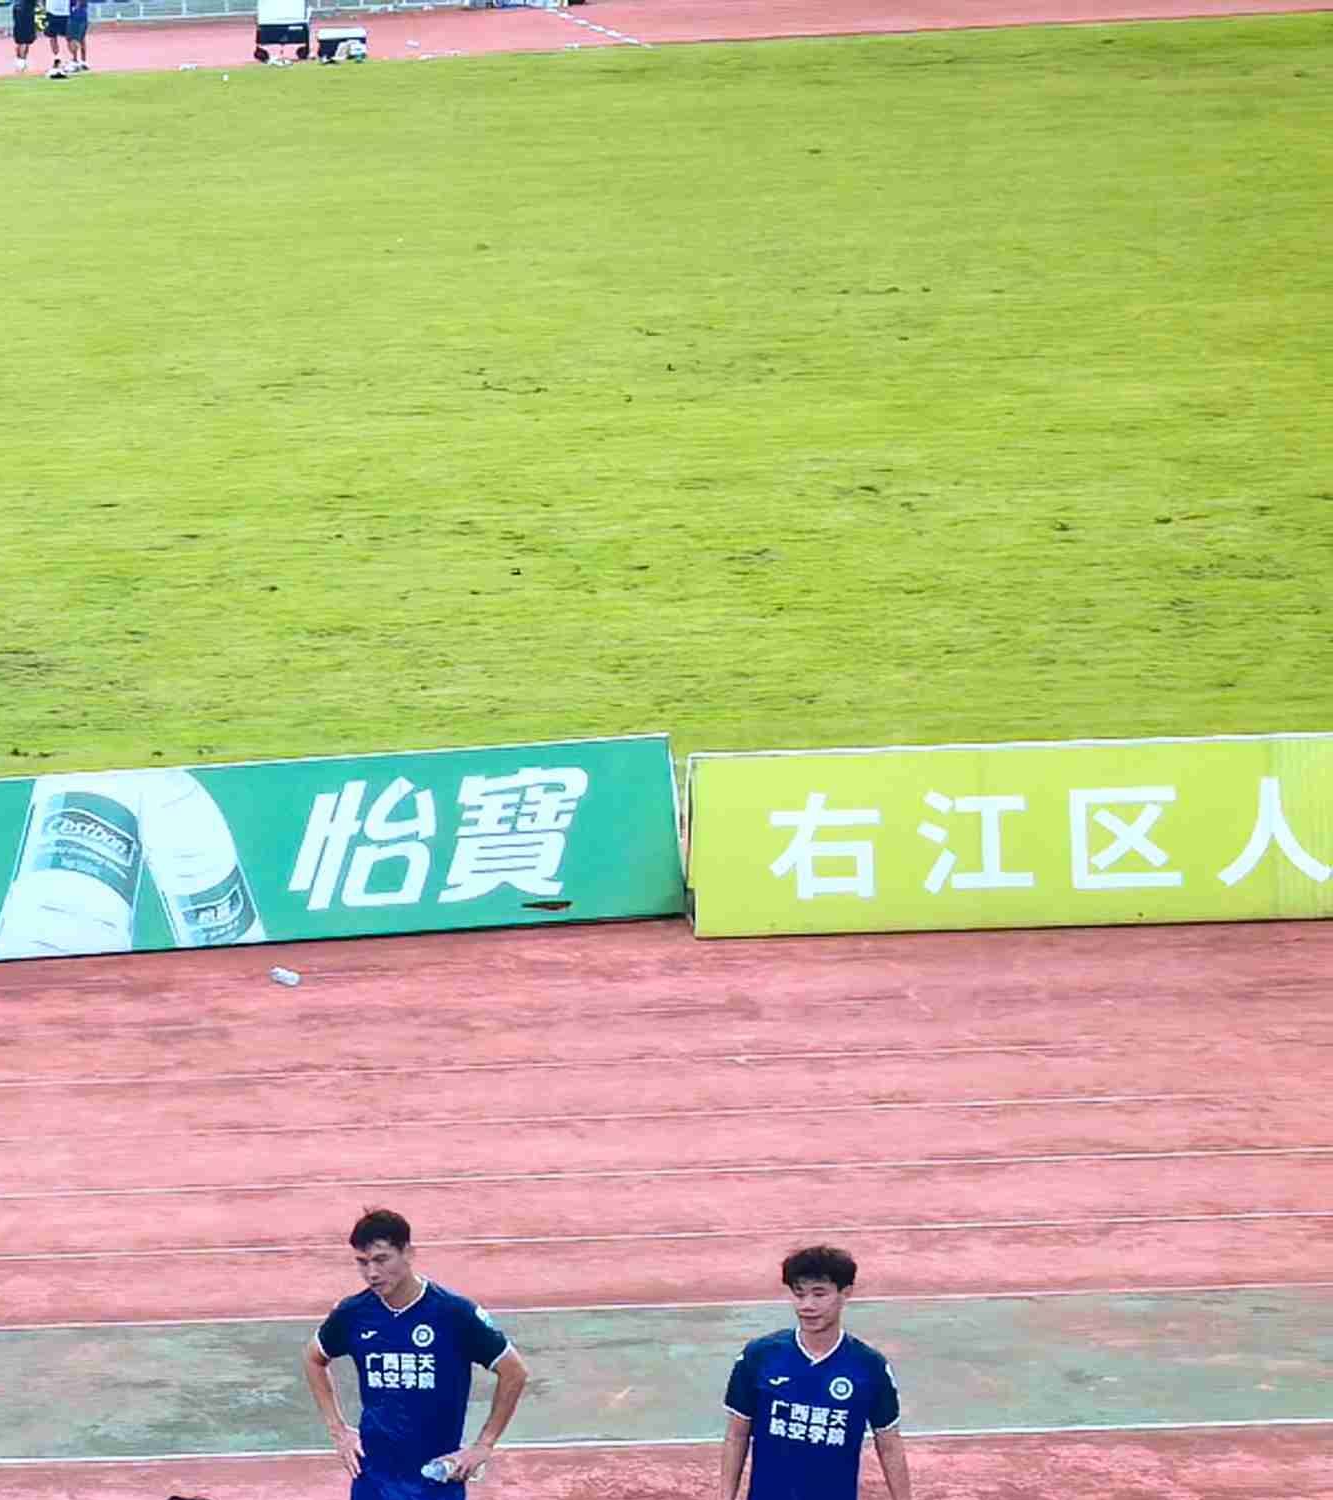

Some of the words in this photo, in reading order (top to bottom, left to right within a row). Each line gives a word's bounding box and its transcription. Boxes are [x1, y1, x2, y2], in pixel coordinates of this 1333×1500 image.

[287, 766, 589, 910] 怡寶
[769, 776, 1333, 900] 右江区人
